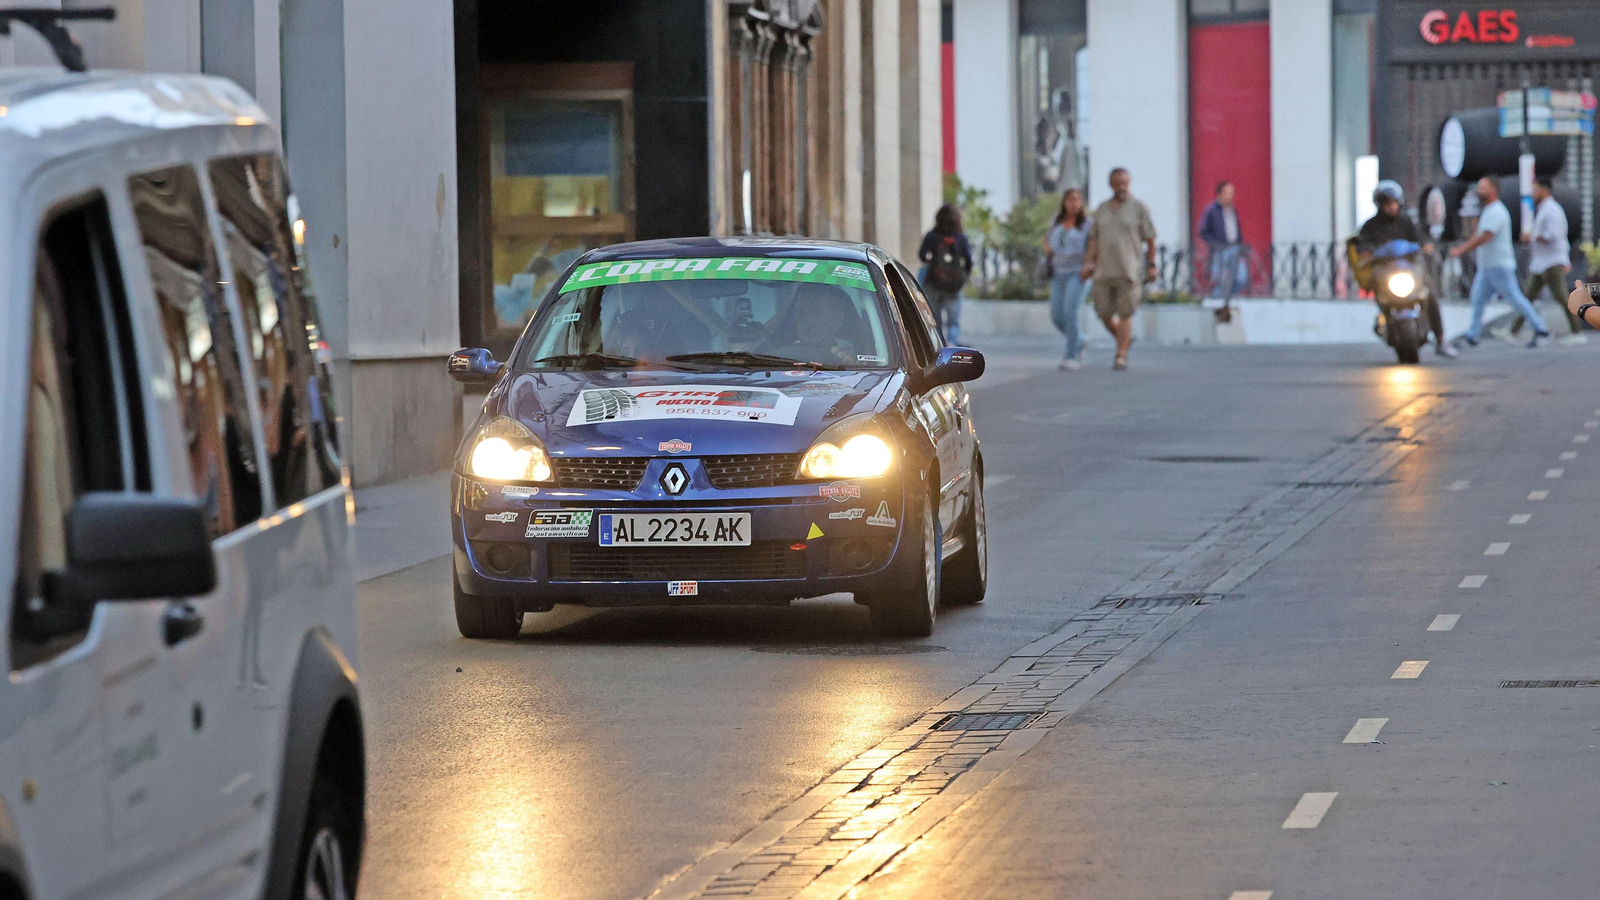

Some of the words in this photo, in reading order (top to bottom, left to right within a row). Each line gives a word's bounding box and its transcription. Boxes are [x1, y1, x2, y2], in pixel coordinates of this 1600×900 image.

[1420, 9, 1520, 44] GAES
[578, 259, 711, 282] COPA
[717, 259, 818, 274] FAA
[665, 408, 767, 418] 956.837.900
[603, 532, 610, 540] E
